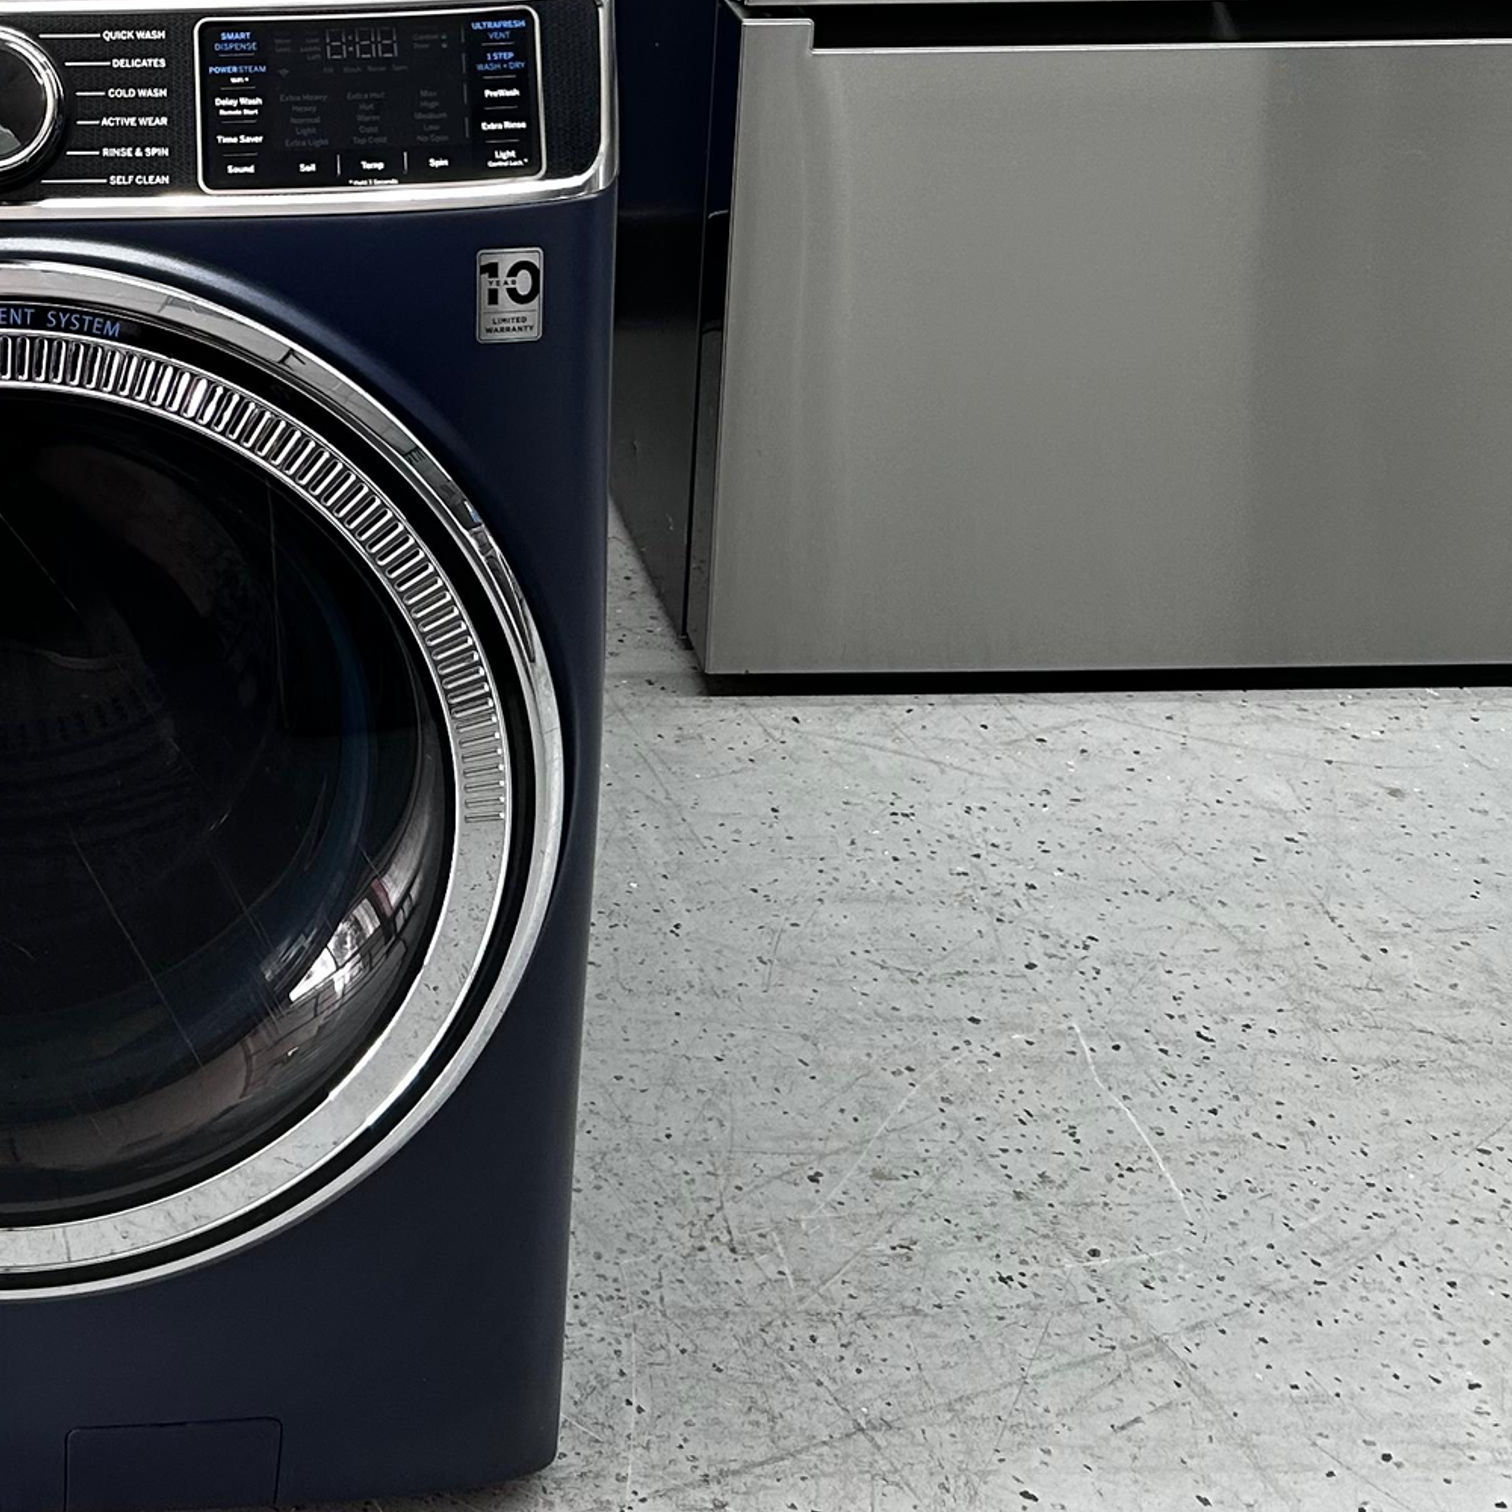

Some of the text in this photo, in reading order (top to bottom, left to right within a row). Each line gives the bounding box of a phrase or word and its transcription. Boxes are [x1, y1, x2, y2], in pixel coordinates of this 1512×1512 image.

[471, 20, 526, 30] ULTRAFRESH
[102, 30, 166, 42] QUICK WASH
[220, 32, 251, 41] SMART
[488, 31, 510, 39] VENT
[214, 42, 257, 51] DISPENSE
[492, 52, 514, 60] STEP
[112, 58, 166, 68] DELICATES
[476, 62, 501, 71] WASH
[108, 88, 168, 98] COLD WASH
[214, 97, 263, 107] Delay Wash
[101, 117, 168, 127] ACTIVE WEAR
[481, 121, 527, 131] Extra Rinse
[216, 134, 263, 144] Time Saver
[102, 147, 169, 157] RINSE & SPIN
[494, 150, 517, 160] Light
[299, 163, 316, 172] Soil
[360, 160, 385, 171] Temp
[428, 157, 449, 168] Spin
[227, 164, 255, 174] Sound
[109, 175, 170, 185] SELF CLEAN
[480, 260, 540, 305] 10
[46, 311, 121, 337] SYSTEM
[492, 316, 528, 325] LIMITED
[486, 325, 534, 334] WARRANTY
